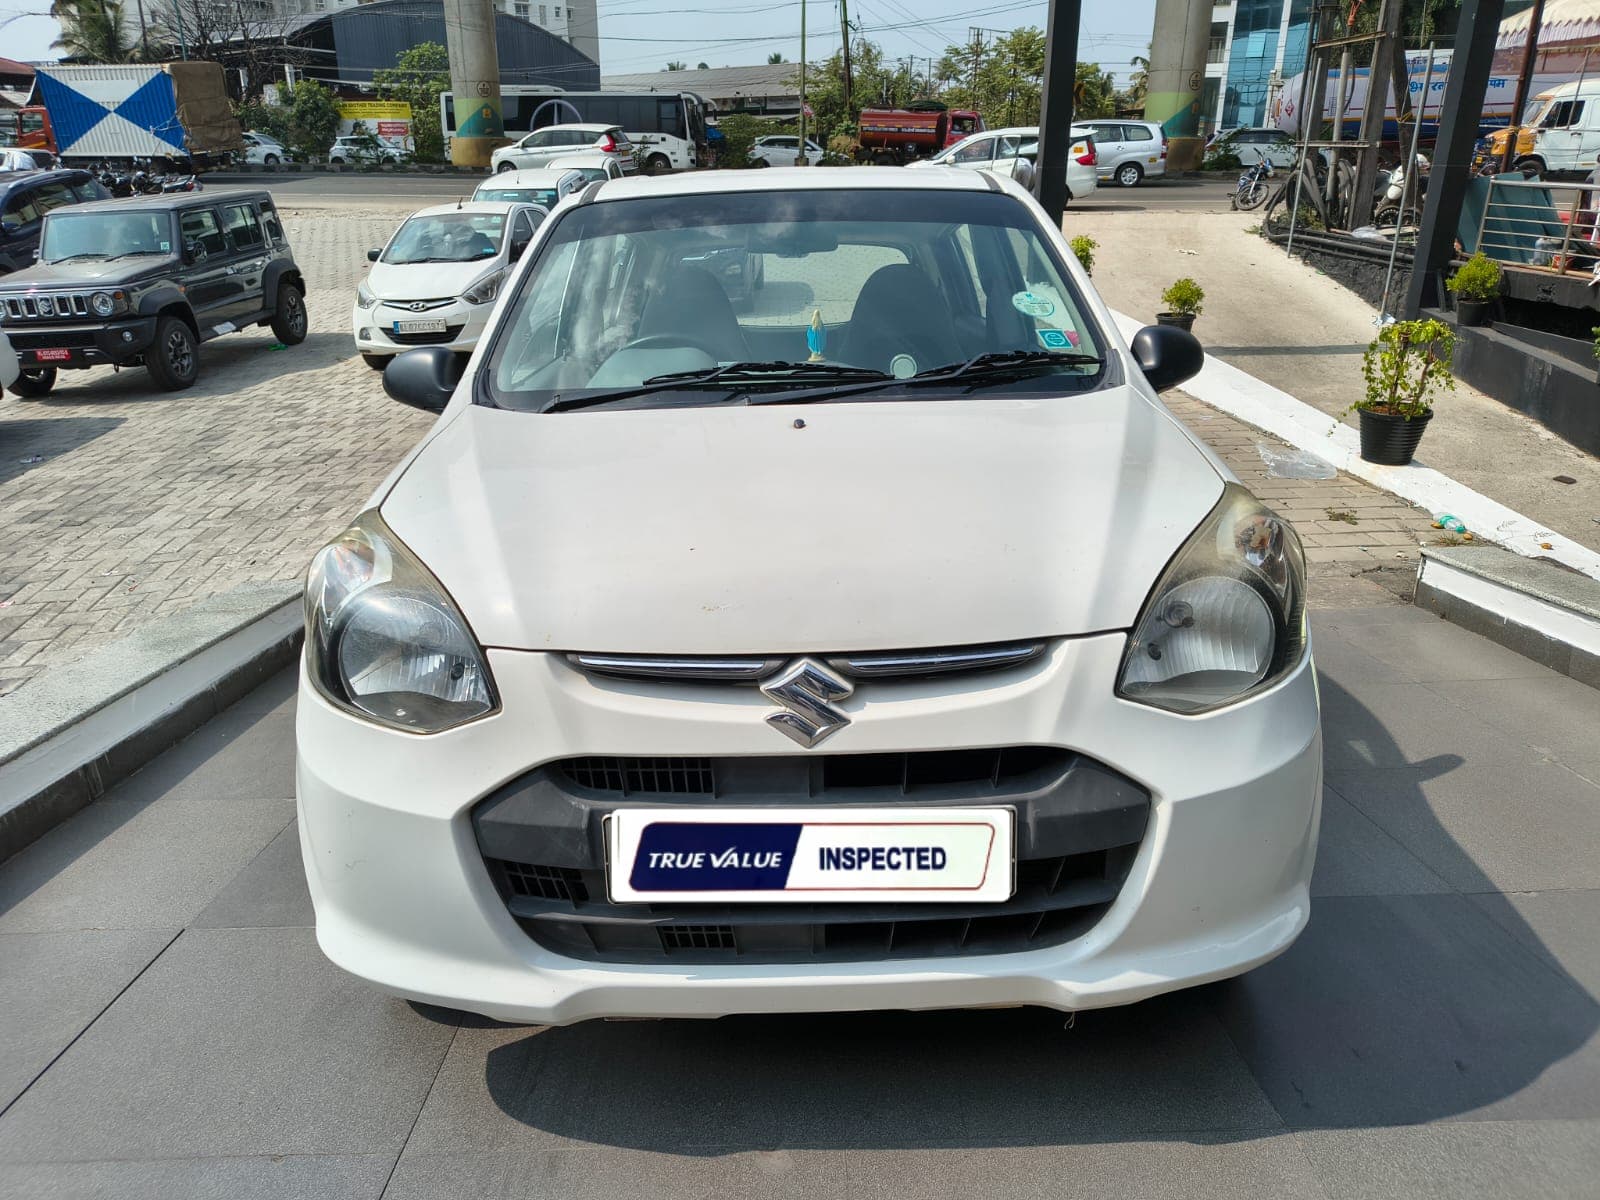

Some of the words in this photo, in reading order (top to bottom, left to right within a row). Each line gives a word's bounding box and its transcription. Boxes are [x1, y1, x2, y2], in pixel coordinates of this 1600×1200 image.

[648, 852, 705, 869] TRUE
[710, 846, 783, 869] VALUE
[818, 846, 947, 871] INSPECTED
